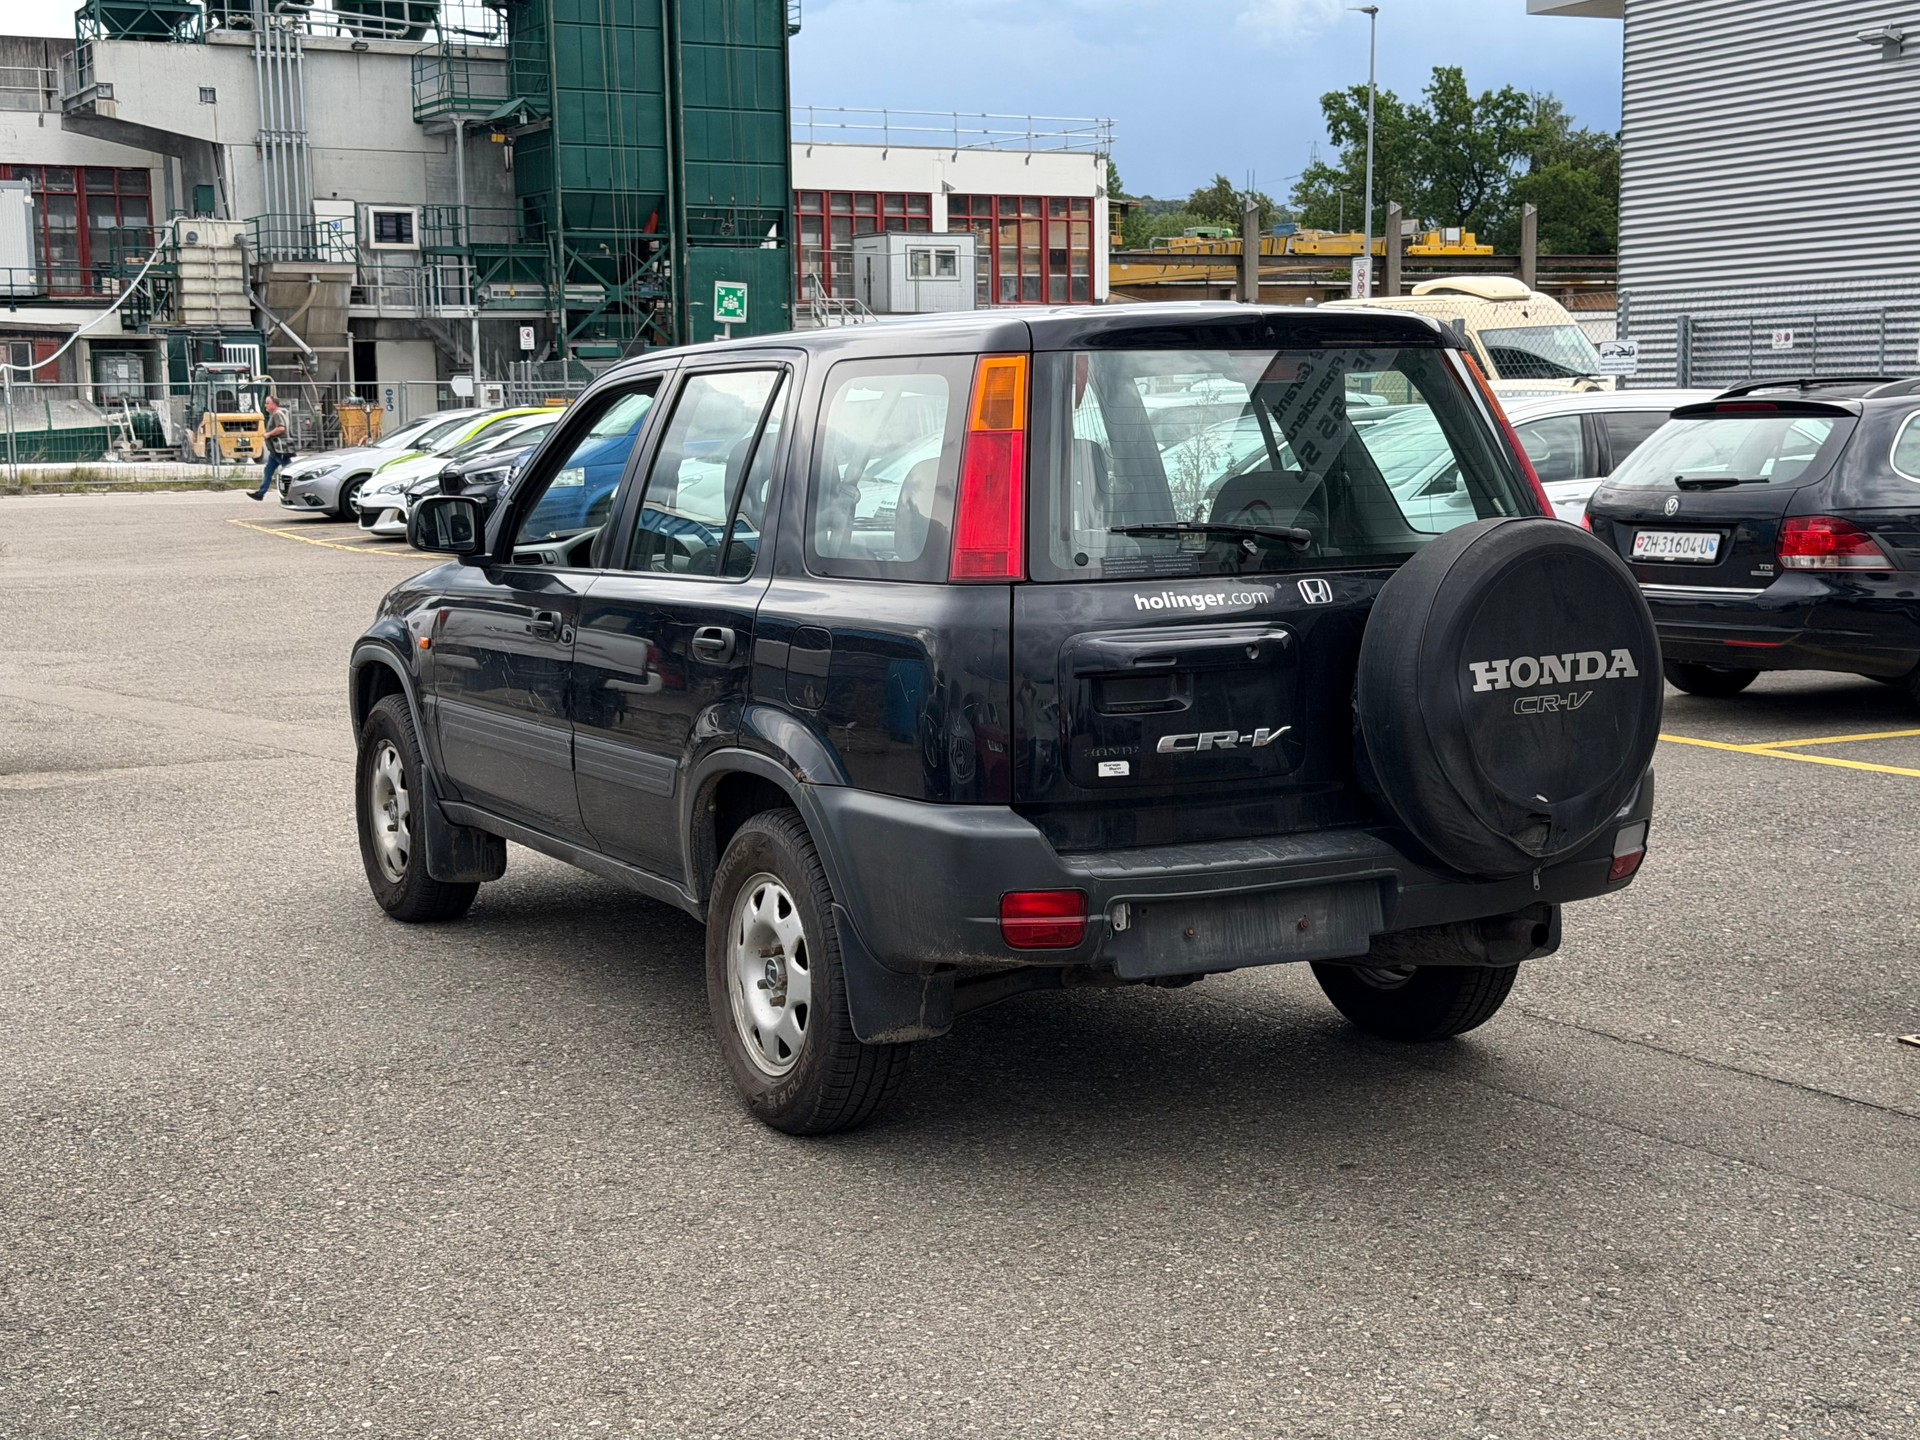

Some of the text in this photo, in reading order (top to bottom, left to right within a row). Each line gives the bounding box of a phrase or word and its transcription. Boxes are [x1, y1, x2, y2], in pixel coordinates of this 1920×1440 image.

[1134, 592, 1269, 611] holinger.com
[1469, 648, 1639, 693] HONDA
[1513, 690, 1594, 715] CR-V
[1156, 725, 1292, 754] CR-V
